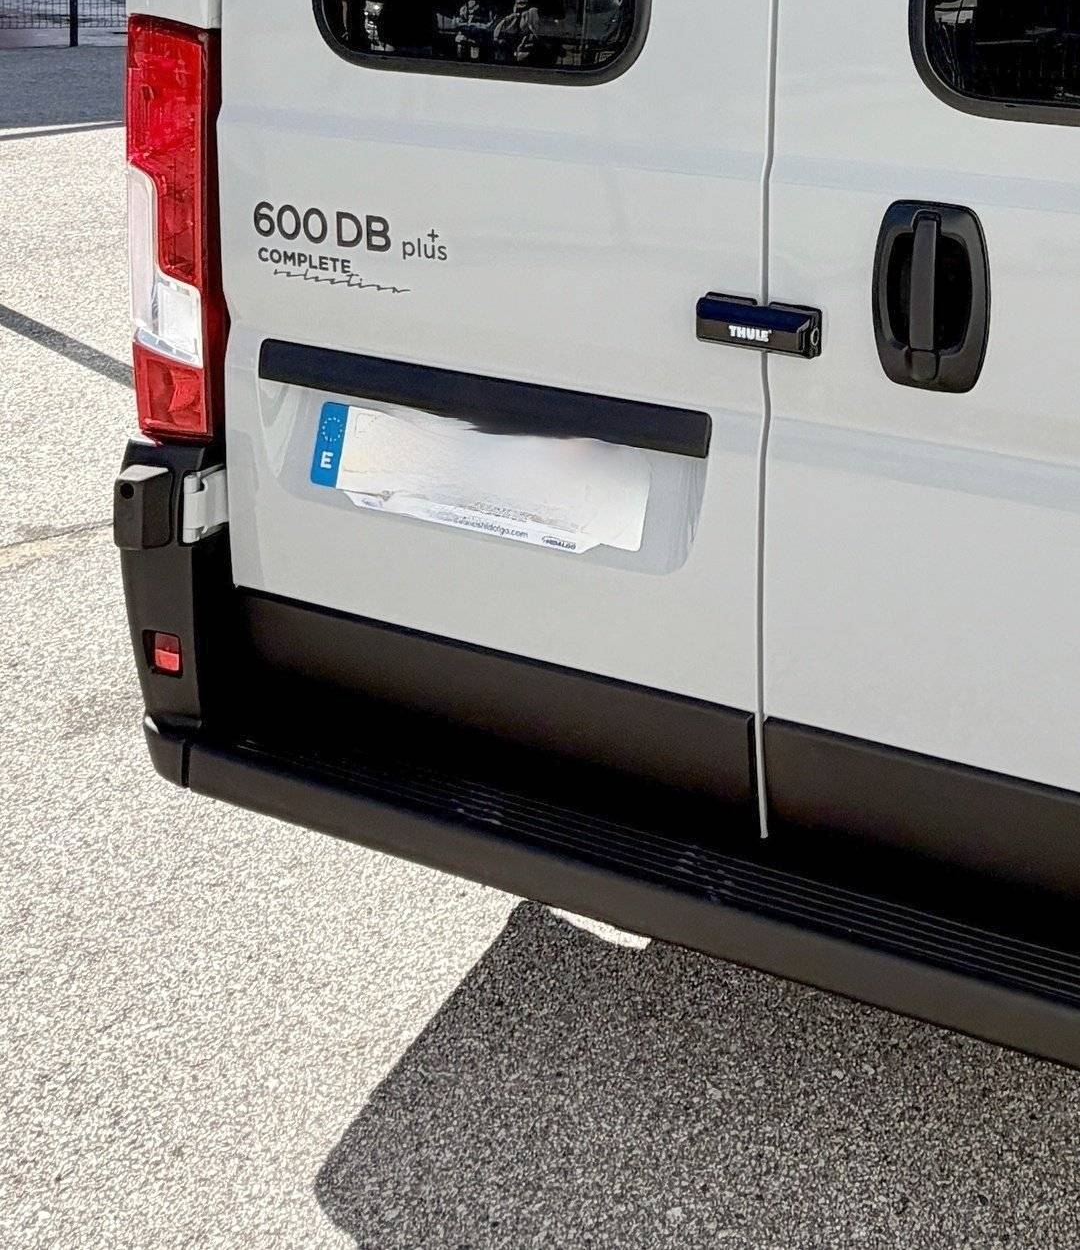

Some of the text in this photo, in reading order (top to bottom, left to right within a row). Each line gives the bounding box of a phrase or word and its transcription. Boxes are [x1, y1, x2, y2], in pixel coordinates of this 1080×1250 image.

[253, 201, 328, 244] 600
[336, 211, 392, 252] DB
[258, 247, 351, 274] COMPLETE
[728, 325, 770, 343] THULE
[320, 451, 334, 469] E
